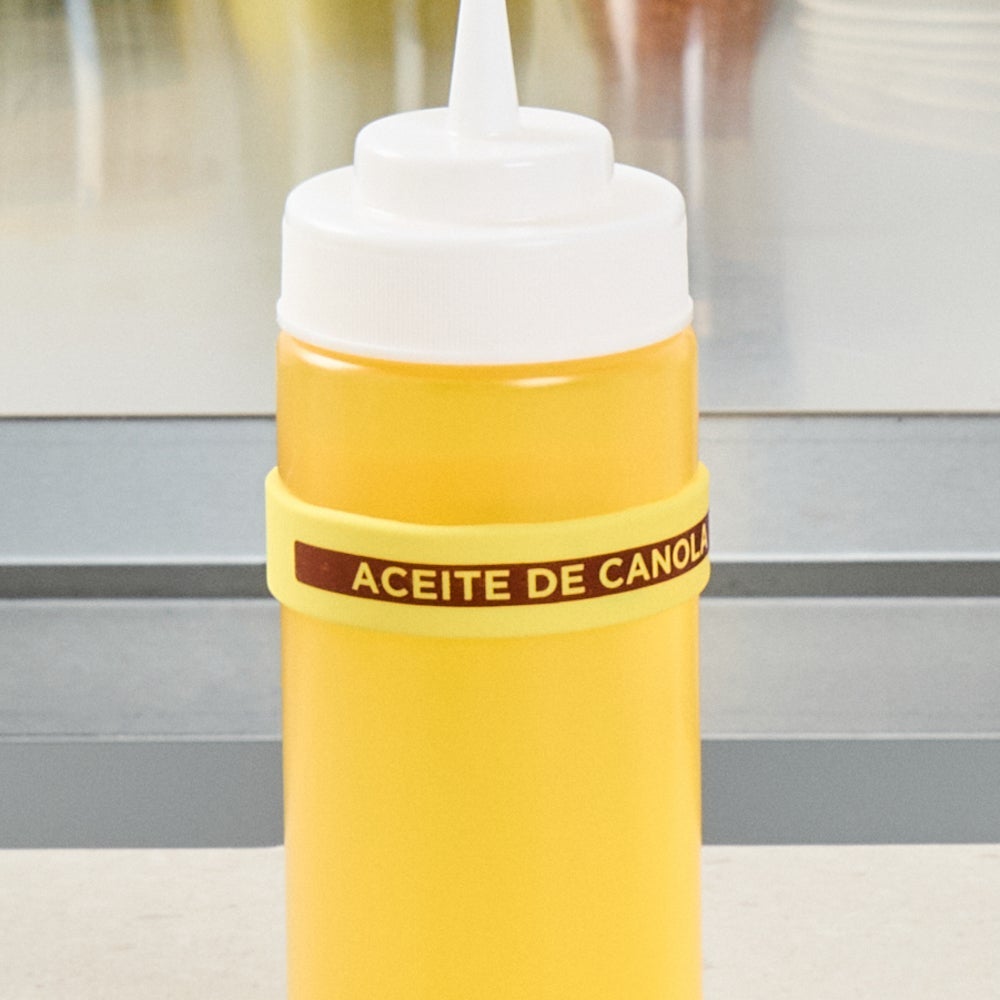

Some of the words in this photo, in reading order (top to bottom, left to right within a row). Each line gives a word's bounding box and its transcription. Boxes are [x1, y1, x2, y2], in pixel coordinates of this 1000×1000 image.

[351, 561, 512, 601] ACEITE
[527, 563, 586, 599] DE
[599, 522, 708, 589] CANOLA
